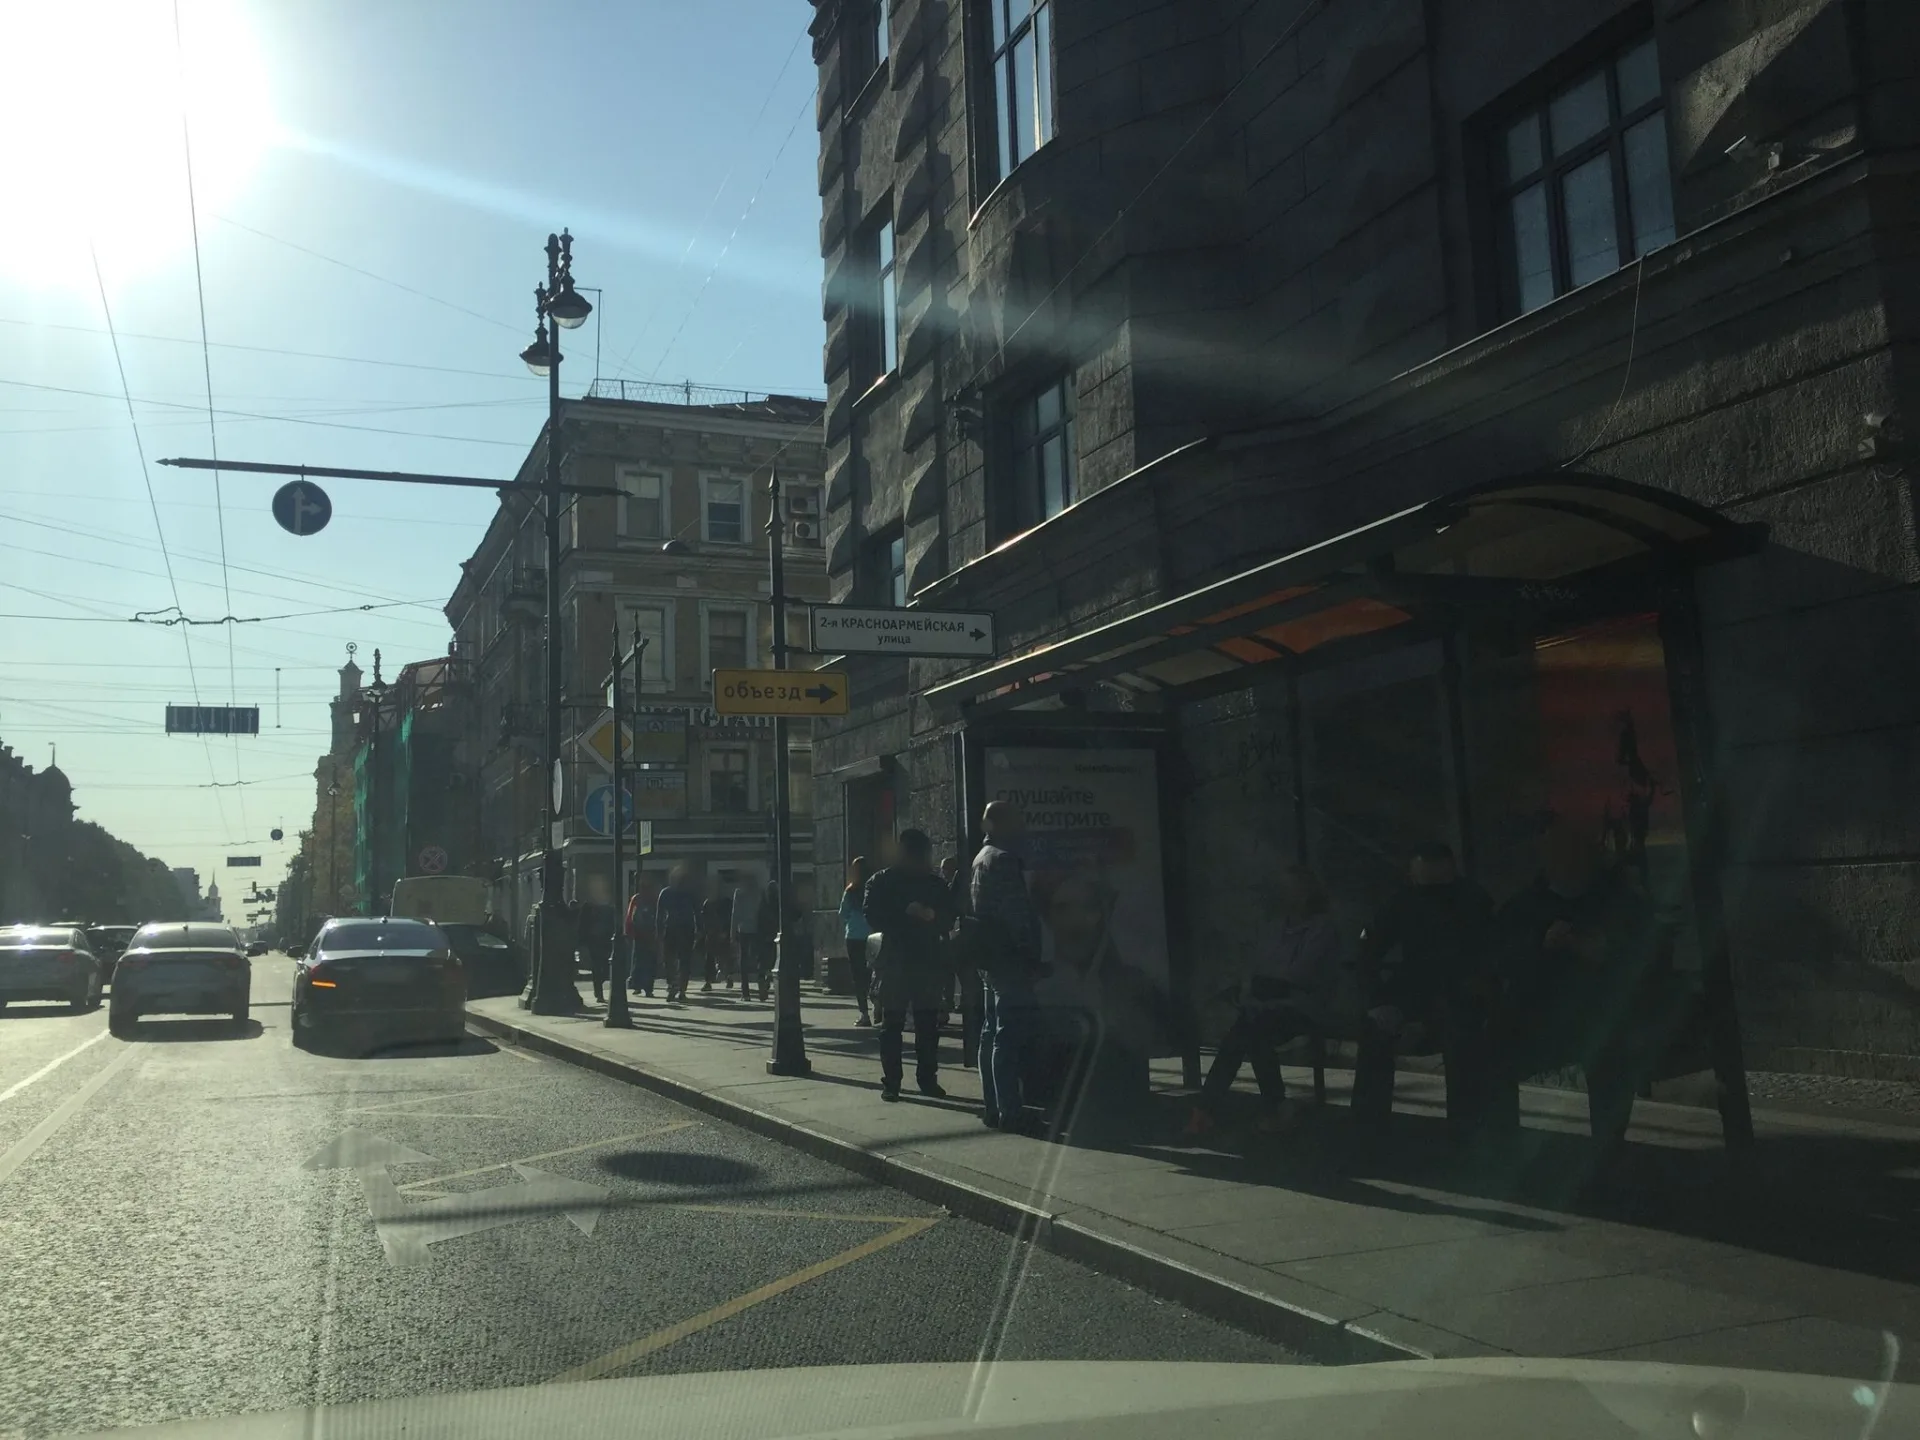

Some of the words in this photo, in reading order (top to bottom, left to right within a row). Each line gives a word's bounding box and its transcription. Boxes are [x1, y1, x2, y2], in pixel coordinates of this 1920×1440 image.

[820, 617, 838, 628] 2-я
[841, 617, 965, 632] КРАСНОАРМЕЙСКАЯ
[877, 635, 911, 646] улица
[724, 681, 801, 701] объезд
[996, 785, 1095, 809] слушайте
[1019, 811, 1111, 830] мотрите
